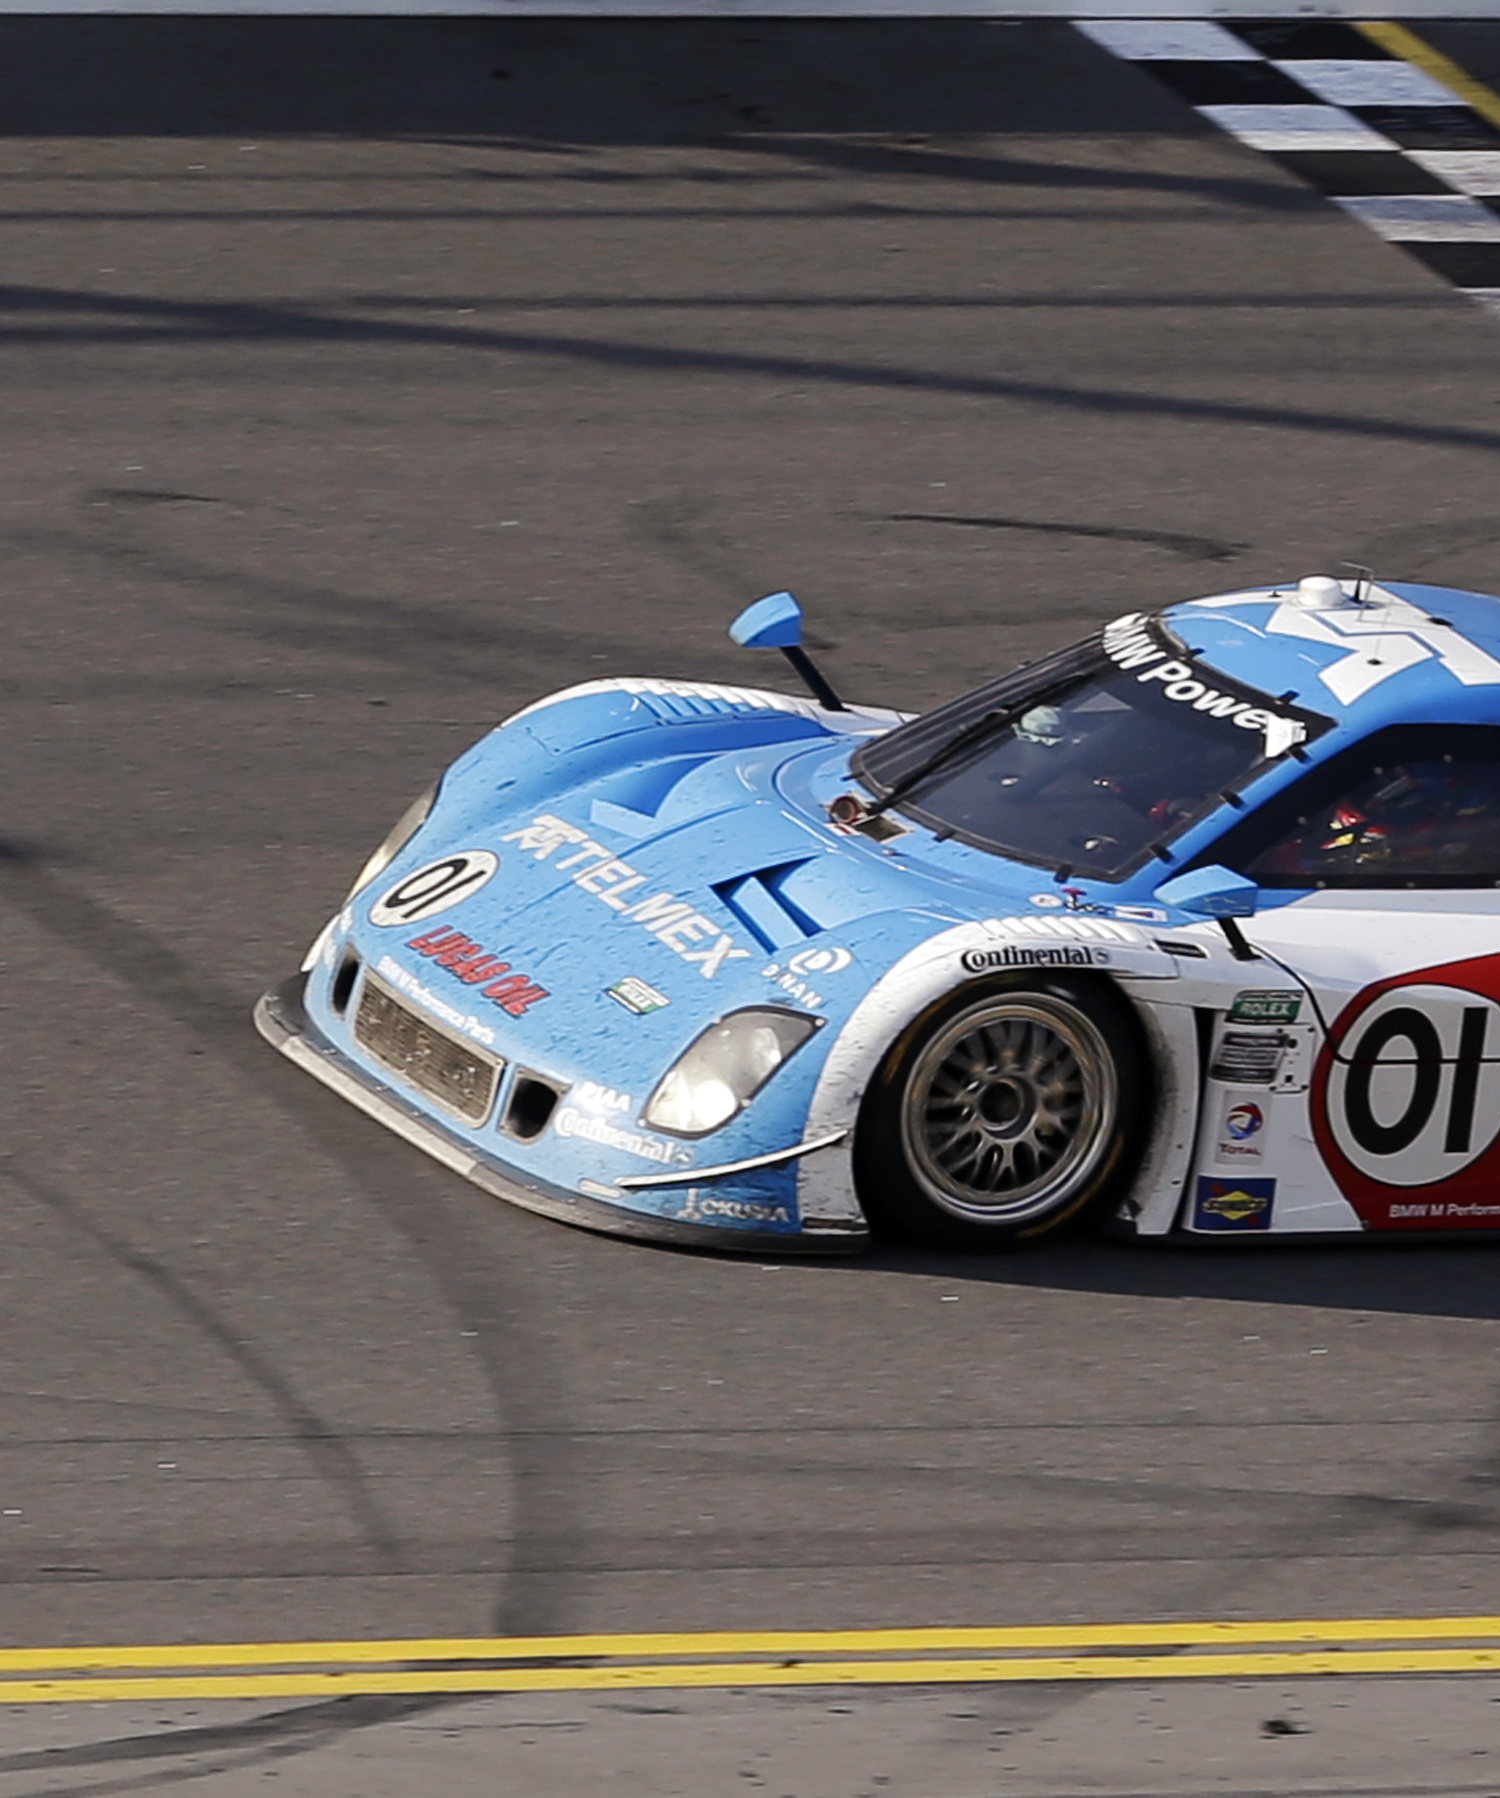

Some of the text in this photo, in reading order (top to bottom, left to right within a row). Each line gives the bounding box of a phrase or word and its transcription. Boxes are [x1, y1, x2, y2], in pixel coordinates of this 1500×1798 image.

[385, 858, 488, 920] 01
[555, 839, 751, 980] TELMEX
[404, 924, 551, 1020] LUCAS OIL
[761, 963, 824, 1009] DINAN
[961, 945, 1094, 973] Continental
[1240, 1002, 1291, 1016] ROLEX
[1344, 1006, 1489, 1156] 01
[555, 1107, 678, 1165] Continental
[1390, 1203, 1425, 1218] BMW
[1429, 1203, 1444, 1217] M
